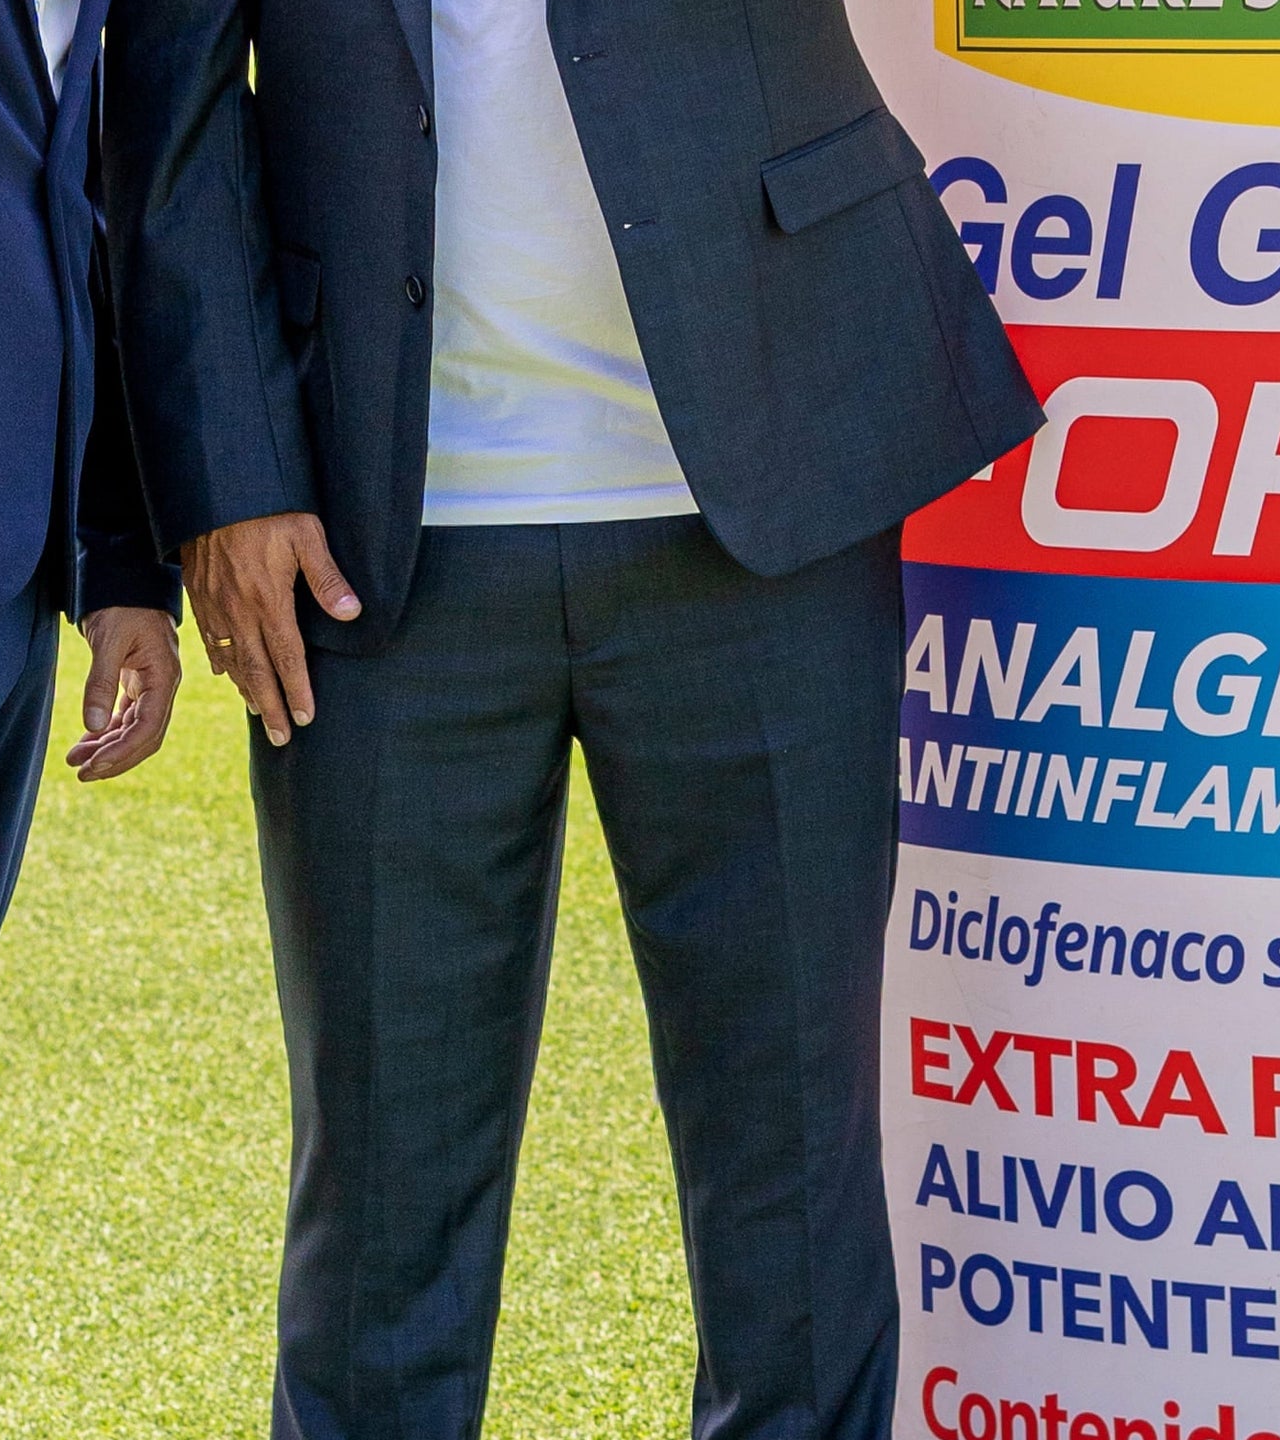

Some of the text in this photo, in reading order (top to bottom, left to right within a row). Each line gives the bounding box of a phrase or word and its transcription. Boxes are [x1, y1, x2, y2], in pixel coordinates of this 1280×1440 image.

[911, 889, 1245, 986] Diclofenaco
[910, 1018, 1226, 1135] EXTRA
[917, 1145, 1174, 1241] ALIVIO
[921, 1244, 1280, 1361] POTENTE
